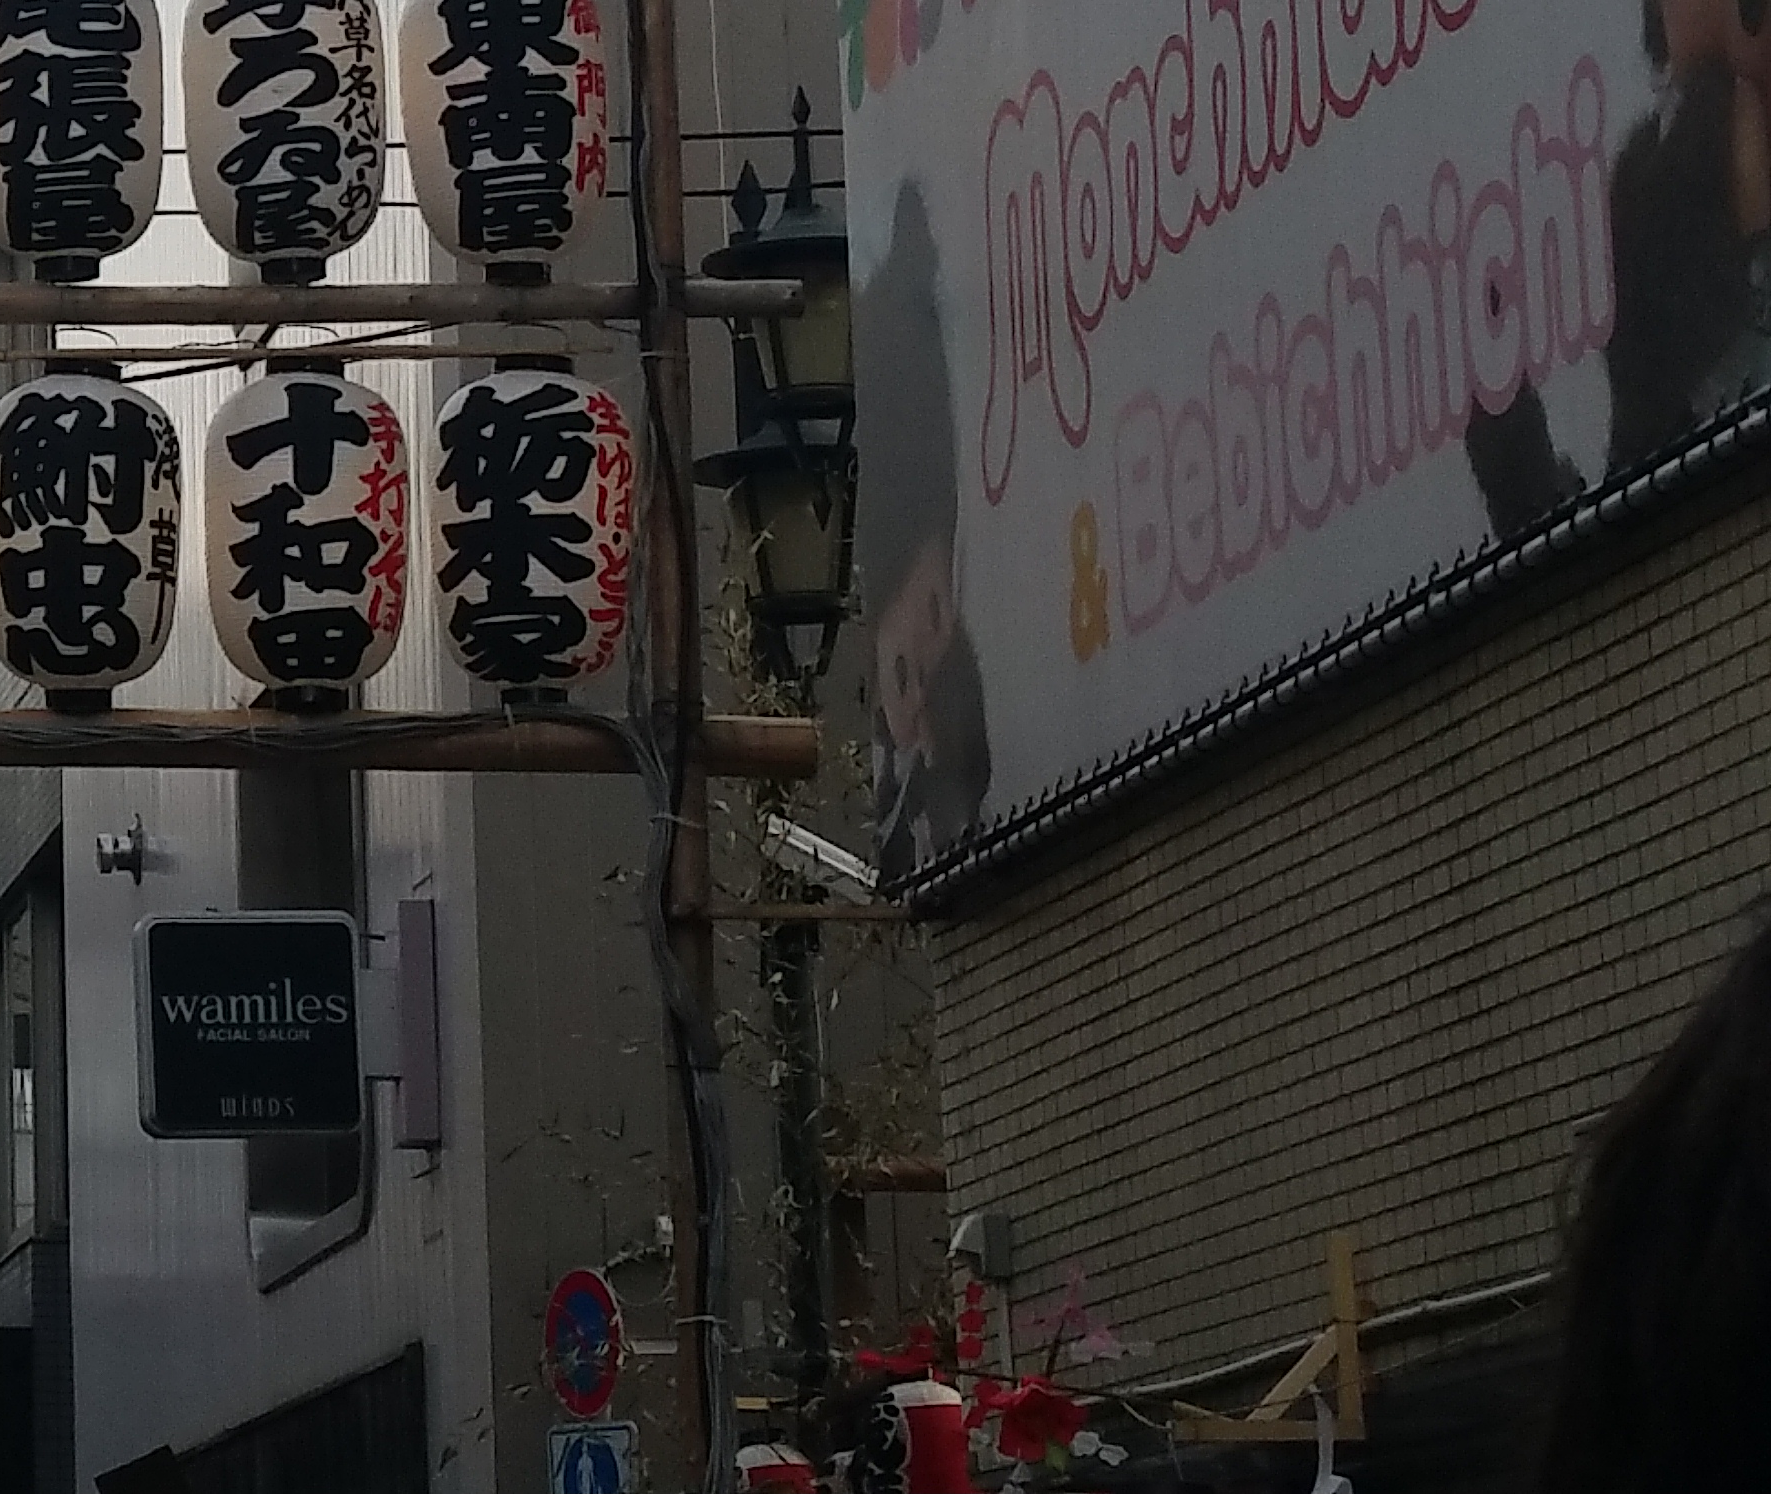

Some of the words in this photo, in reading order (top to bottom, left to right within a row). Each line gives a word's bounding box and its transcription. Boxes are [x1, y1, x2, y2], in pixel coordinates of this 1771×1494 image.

[1069, 500, 1107, 664] &
[1113, 54, 1616, 638] Bebichhichi
[227, 385, 380, 683] 十和田
[360, 406, 408, 637] 手打そば
[160, 976, 349, 1026] wamiles
[196, 1028, 251, 1043] FACIAL
[256, 1028, 312, 1043] SALON
